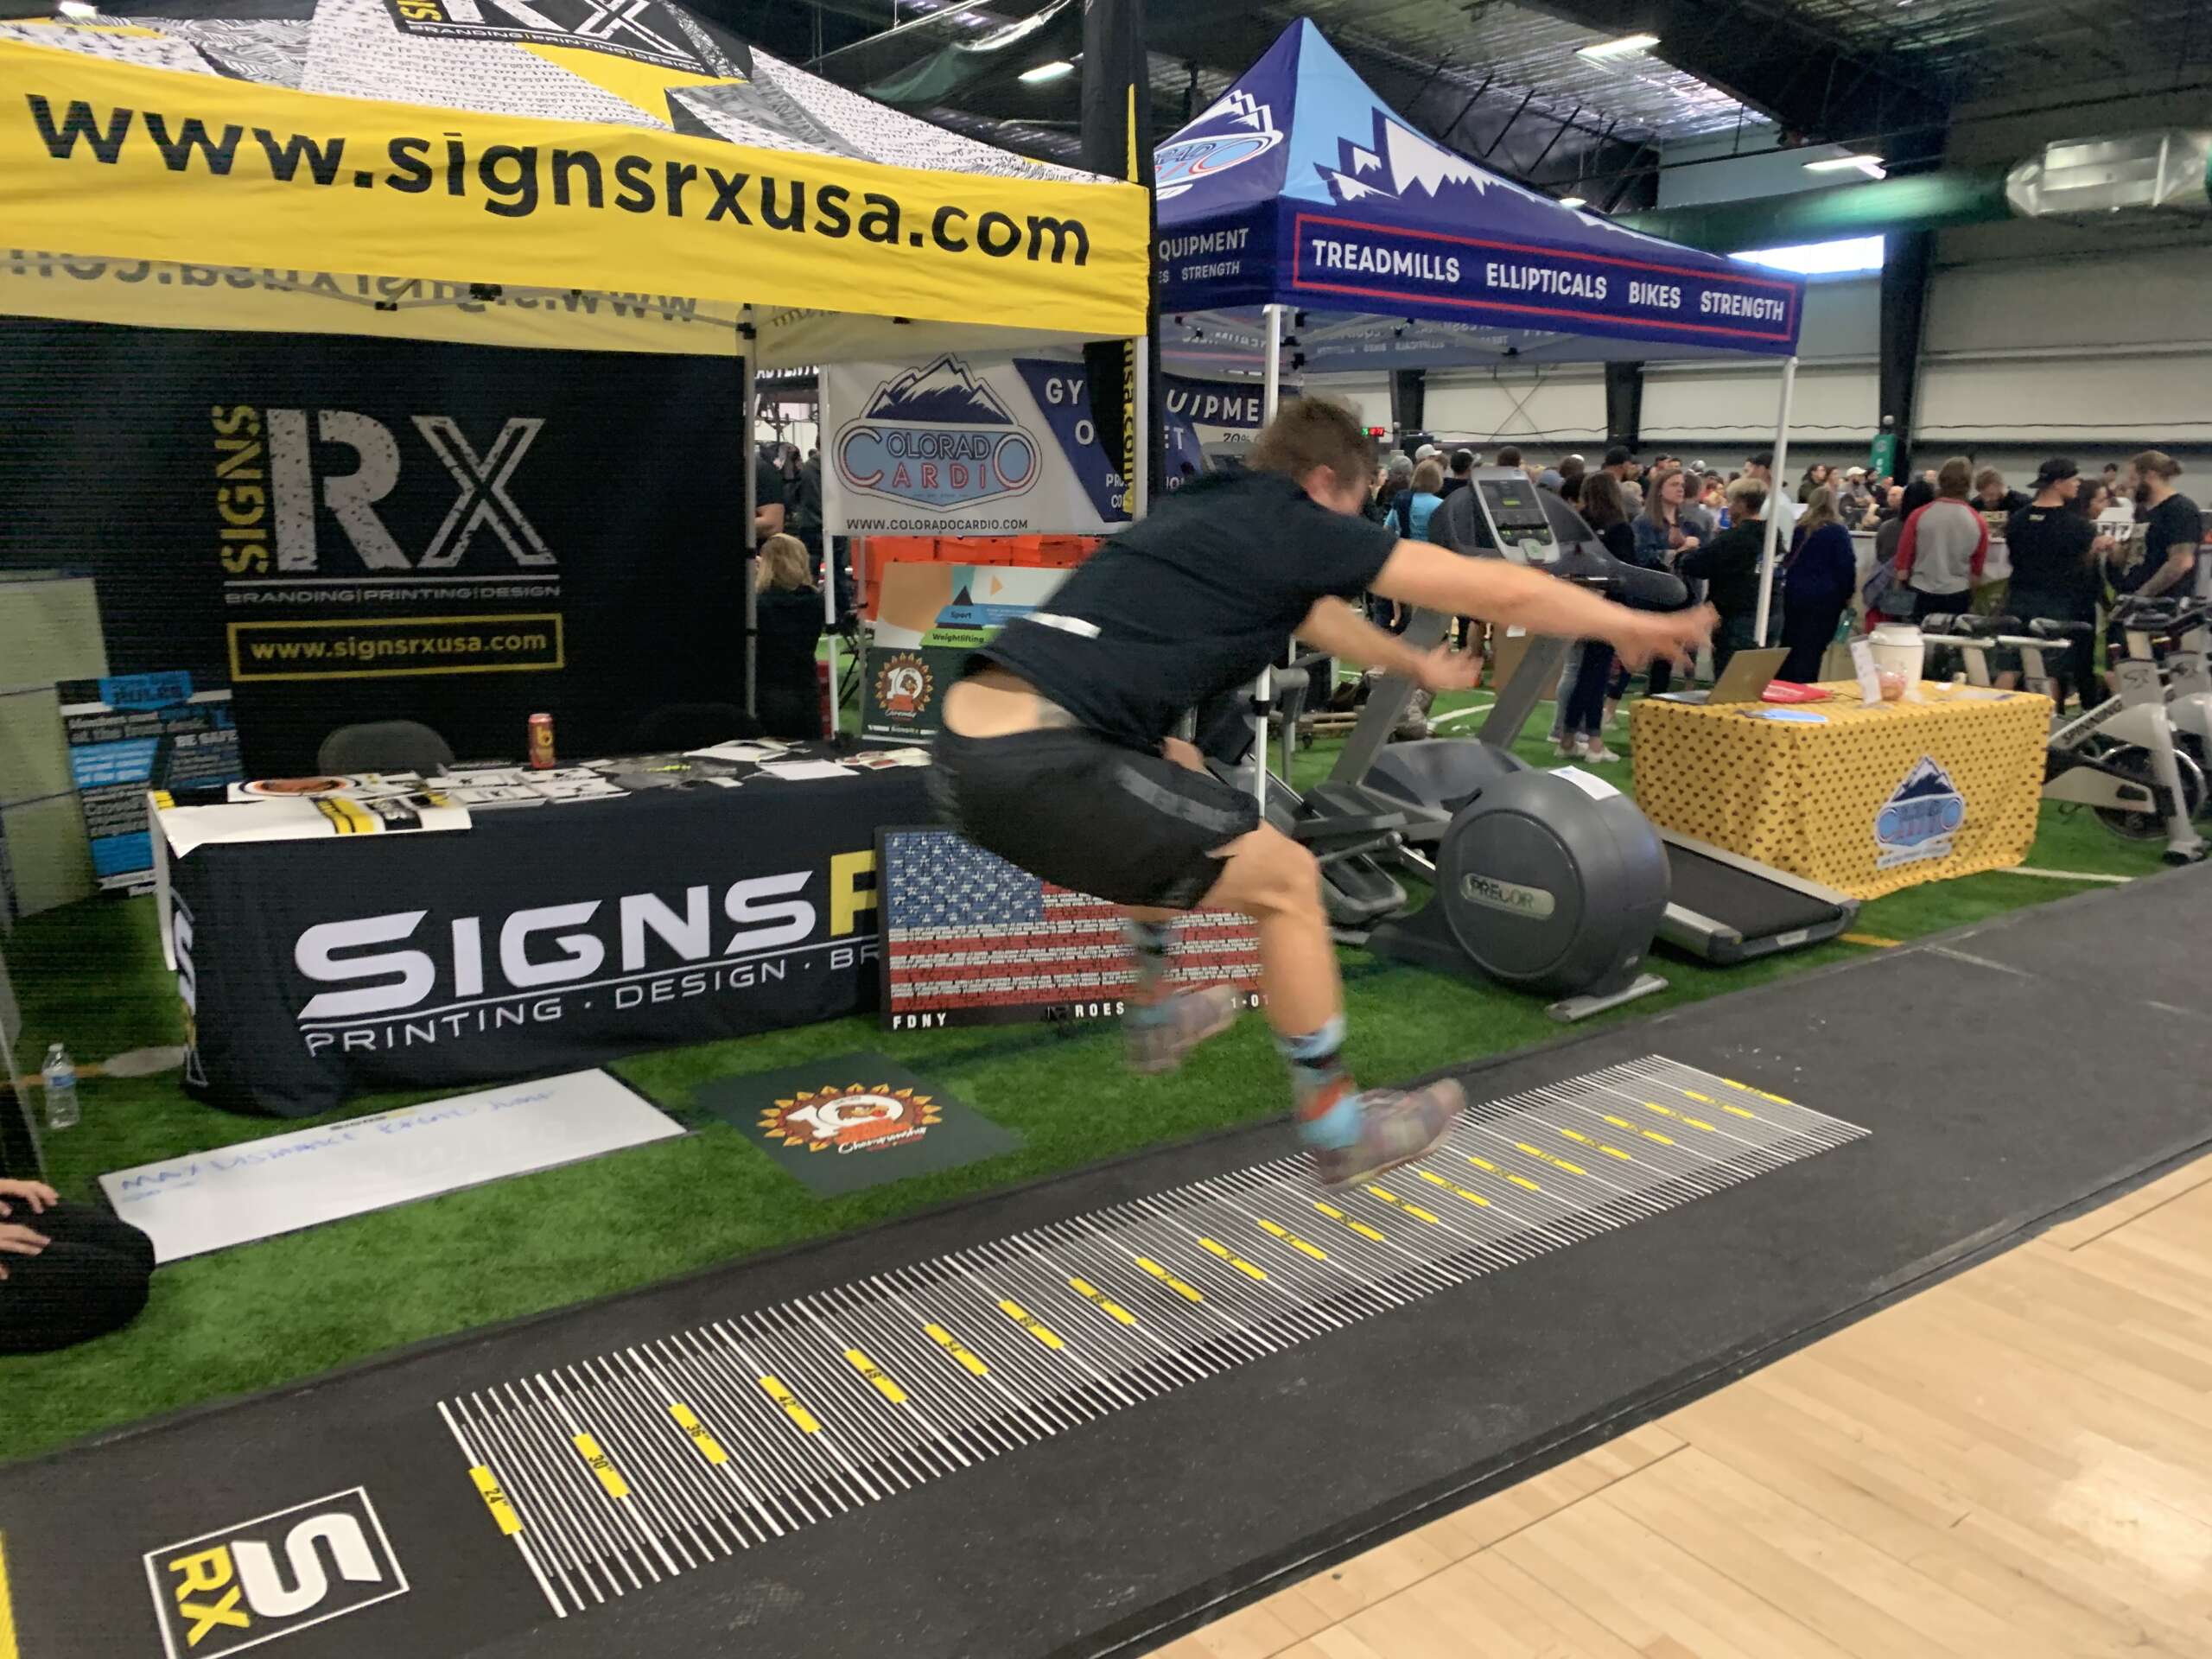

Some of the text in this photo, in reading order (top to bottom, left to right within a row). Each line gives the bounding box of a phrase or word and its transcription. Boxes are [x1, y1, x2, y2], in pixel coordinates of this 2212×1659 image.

[24, 92, 1090, 266] www.signsrxusa.com
[1159, 228, 1249, 261] QUIPMENT
[1181, 261, 1240, 281] STRENGTH
[1313, 239, 1784, 322] TREADMILLS ELLIPTICALS BIKES STRENGTH
[1046, 378, 1259, 422] GY UIPME
[212, 405, 269, 574] SIGNS
[267, 409, 558, 571] RX
[847, 518, 1028, 531] WWW.COLORADOCARDIO.COM
[251, 632, 547, 661] www.signsrxusa.com
[932, 632, 984, 644] Weightlifting
[1470, 876, 1535, 910] PRECOR
[295, 849, 878, 1020] SIGNSR
[303, 944, 878, 1058] PRINTING DESIGN BR
[893, 1012, 947, 1030] FDNY
[778, 1395, 802, 1410] 42"
[686, 1423, 711, 1440] 36"
[588, 1453, 614, 1472] 30"
[484, 1487, 510, 1507] 24"
[231, 1512, 383, 1618] S
[168, 1544, 251, 1648] RX
